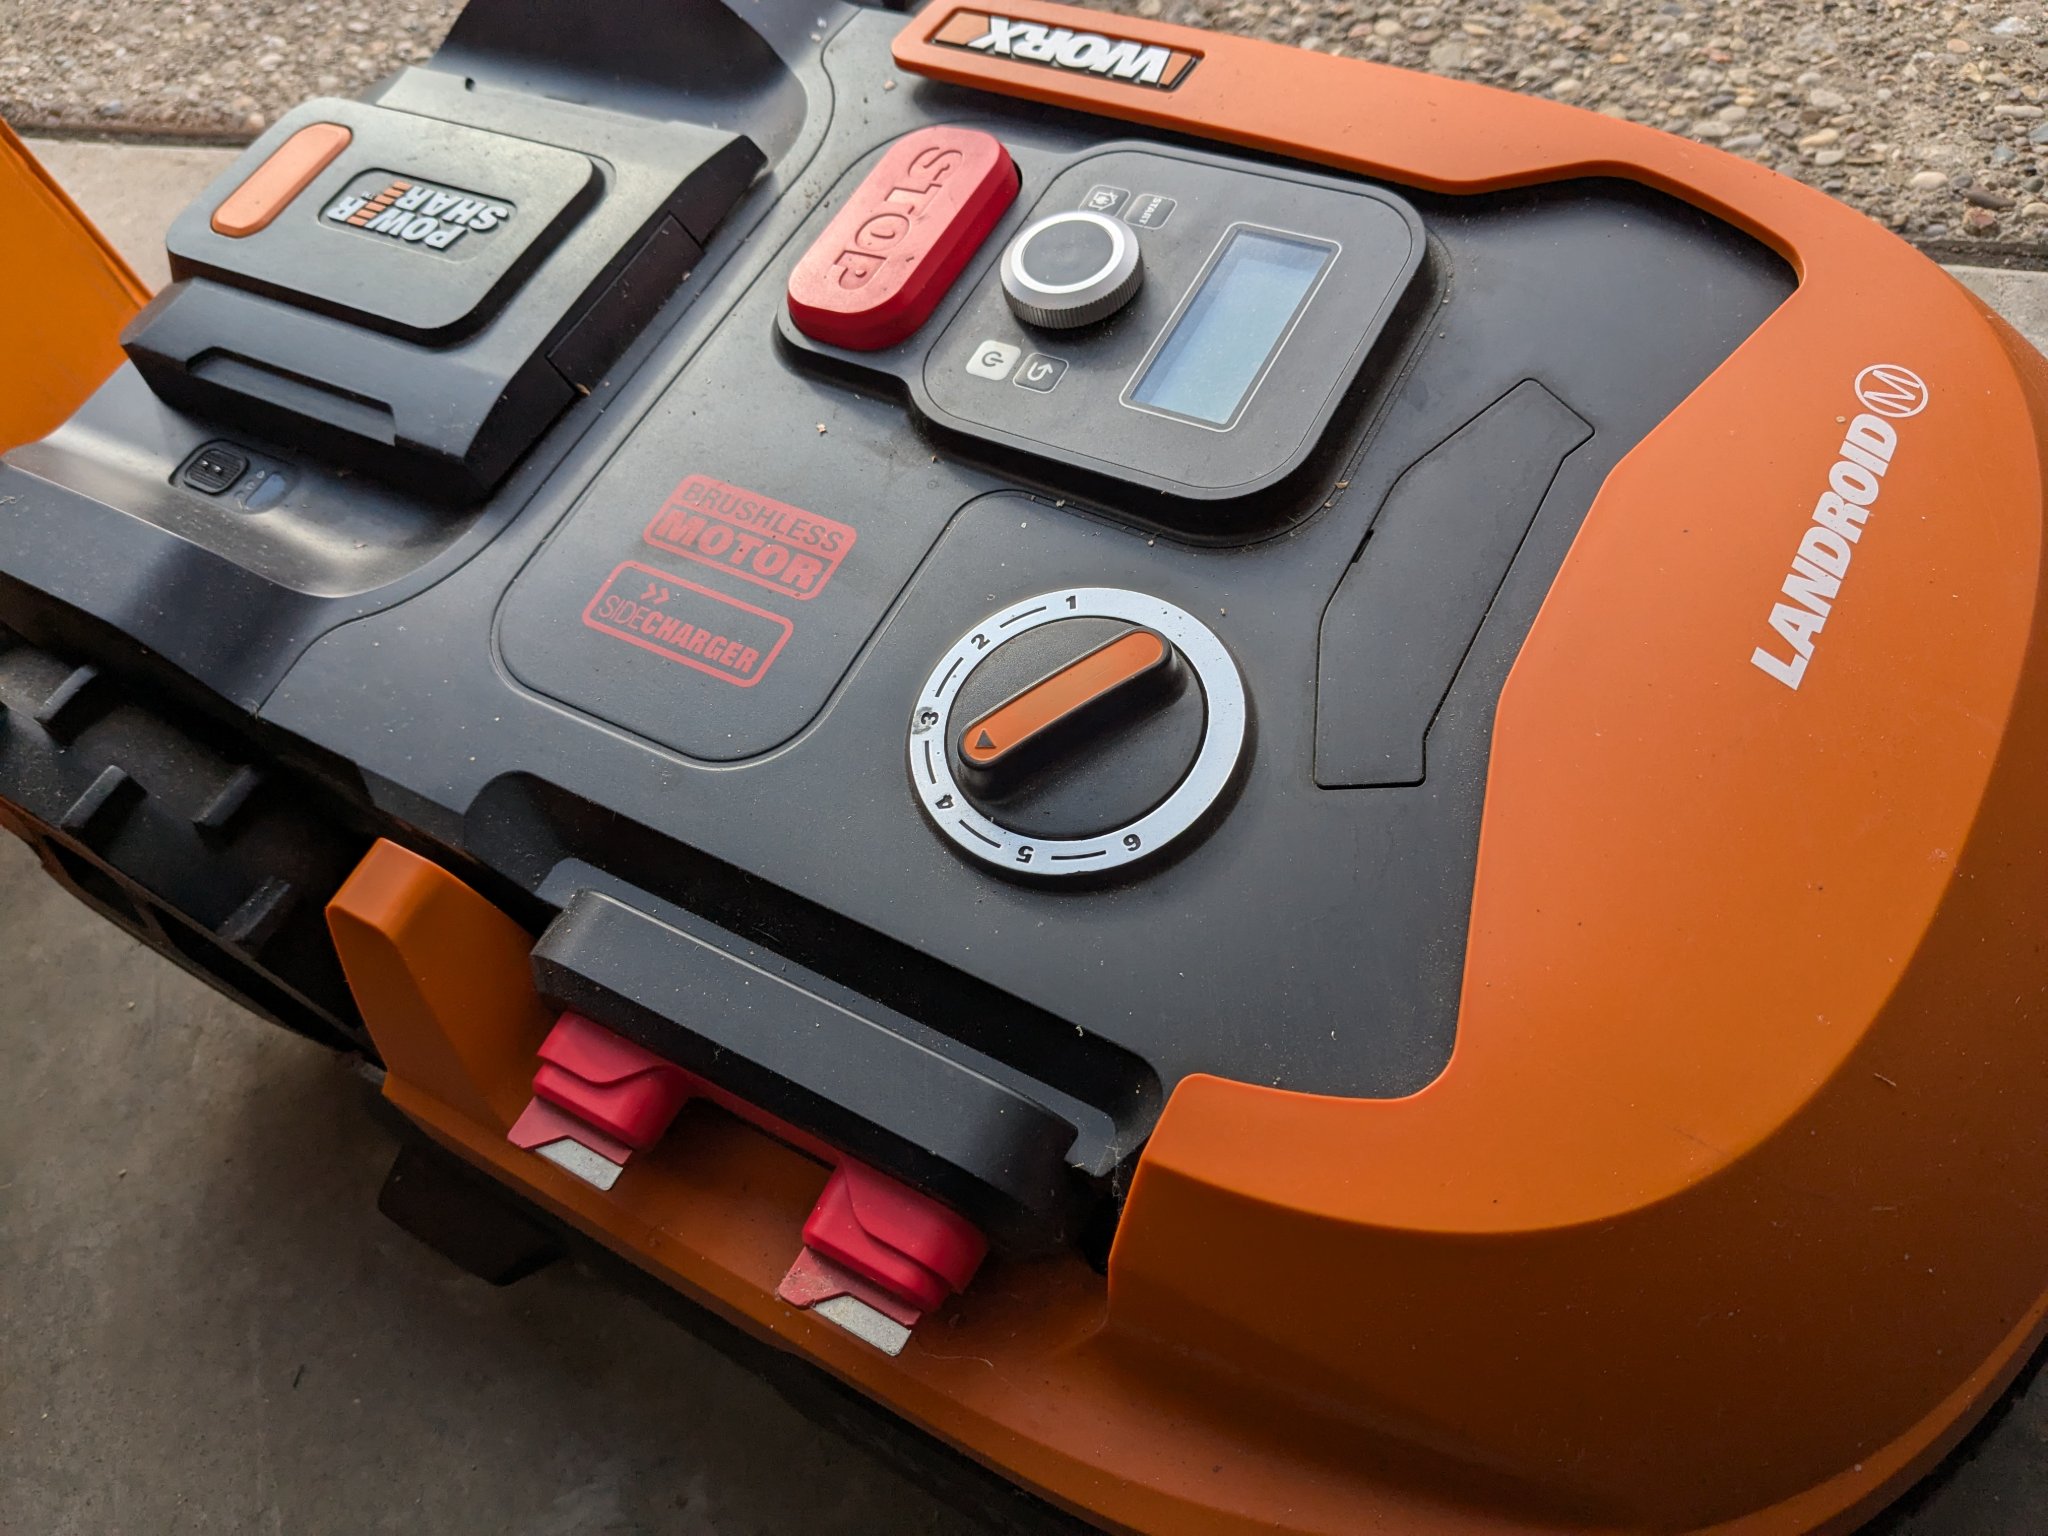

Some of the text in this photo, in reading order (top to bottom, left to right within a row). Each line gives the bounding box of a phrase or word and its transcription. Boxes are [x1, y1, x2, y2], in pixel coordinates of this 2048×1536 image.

[967, 16, 1170, 83] WORX
[327, 196, 466, 249] POWER
[373, 180, 508, 231] SHARE
[834, 147, 962, 289] STOP
[1139, 197, 1162, 225] START
[682, 482, 844, 552] BRUSHLESS
[655, 511, 823, 589] MOTOR
[1751, 413, 1897, 690] LANDROID
[1066, 595, 1077, 610] 1
[599, 595, 759, 673] SIDECHARGER
[971, 633, 991, 650] 2
[921, 711, 939, 725] 3
[935, 794, 954, 809] 4
[1016, 845, 1034, 863] 5
[1123, 834, 1141, 852] 6
